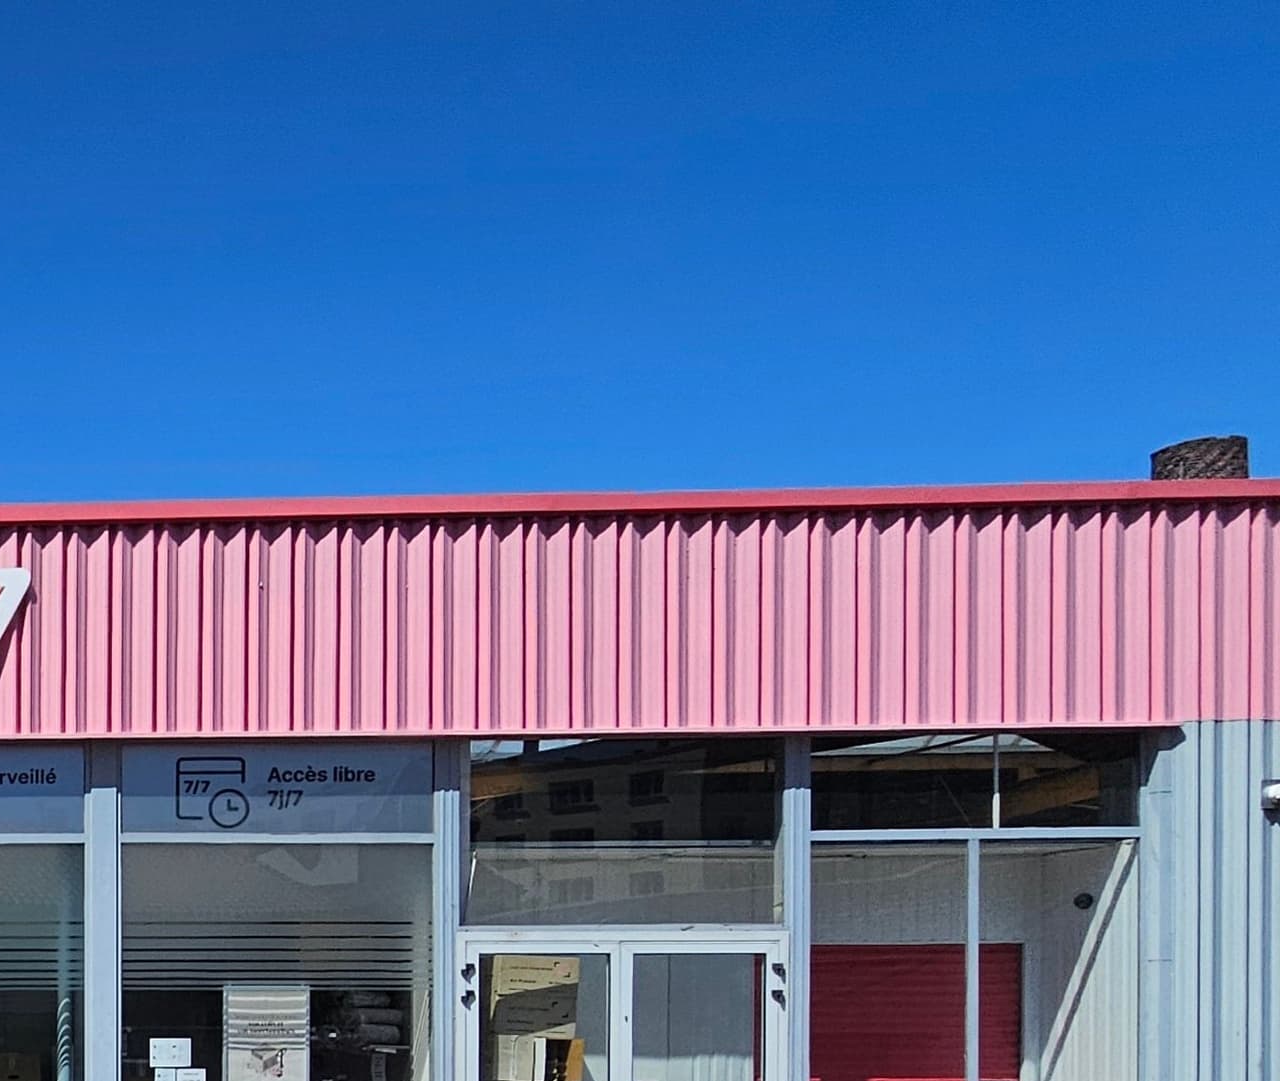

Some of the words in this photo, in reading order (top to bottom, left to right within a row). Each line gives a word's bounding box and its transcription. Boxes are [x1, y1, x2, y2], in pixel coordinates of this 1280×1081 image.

[267, 766, 328, 783] Accès
[333, 766, 376, 783] libre
[183, 780, 211, 795] 7/7
[267, 790, 304, 810] 7j/7
